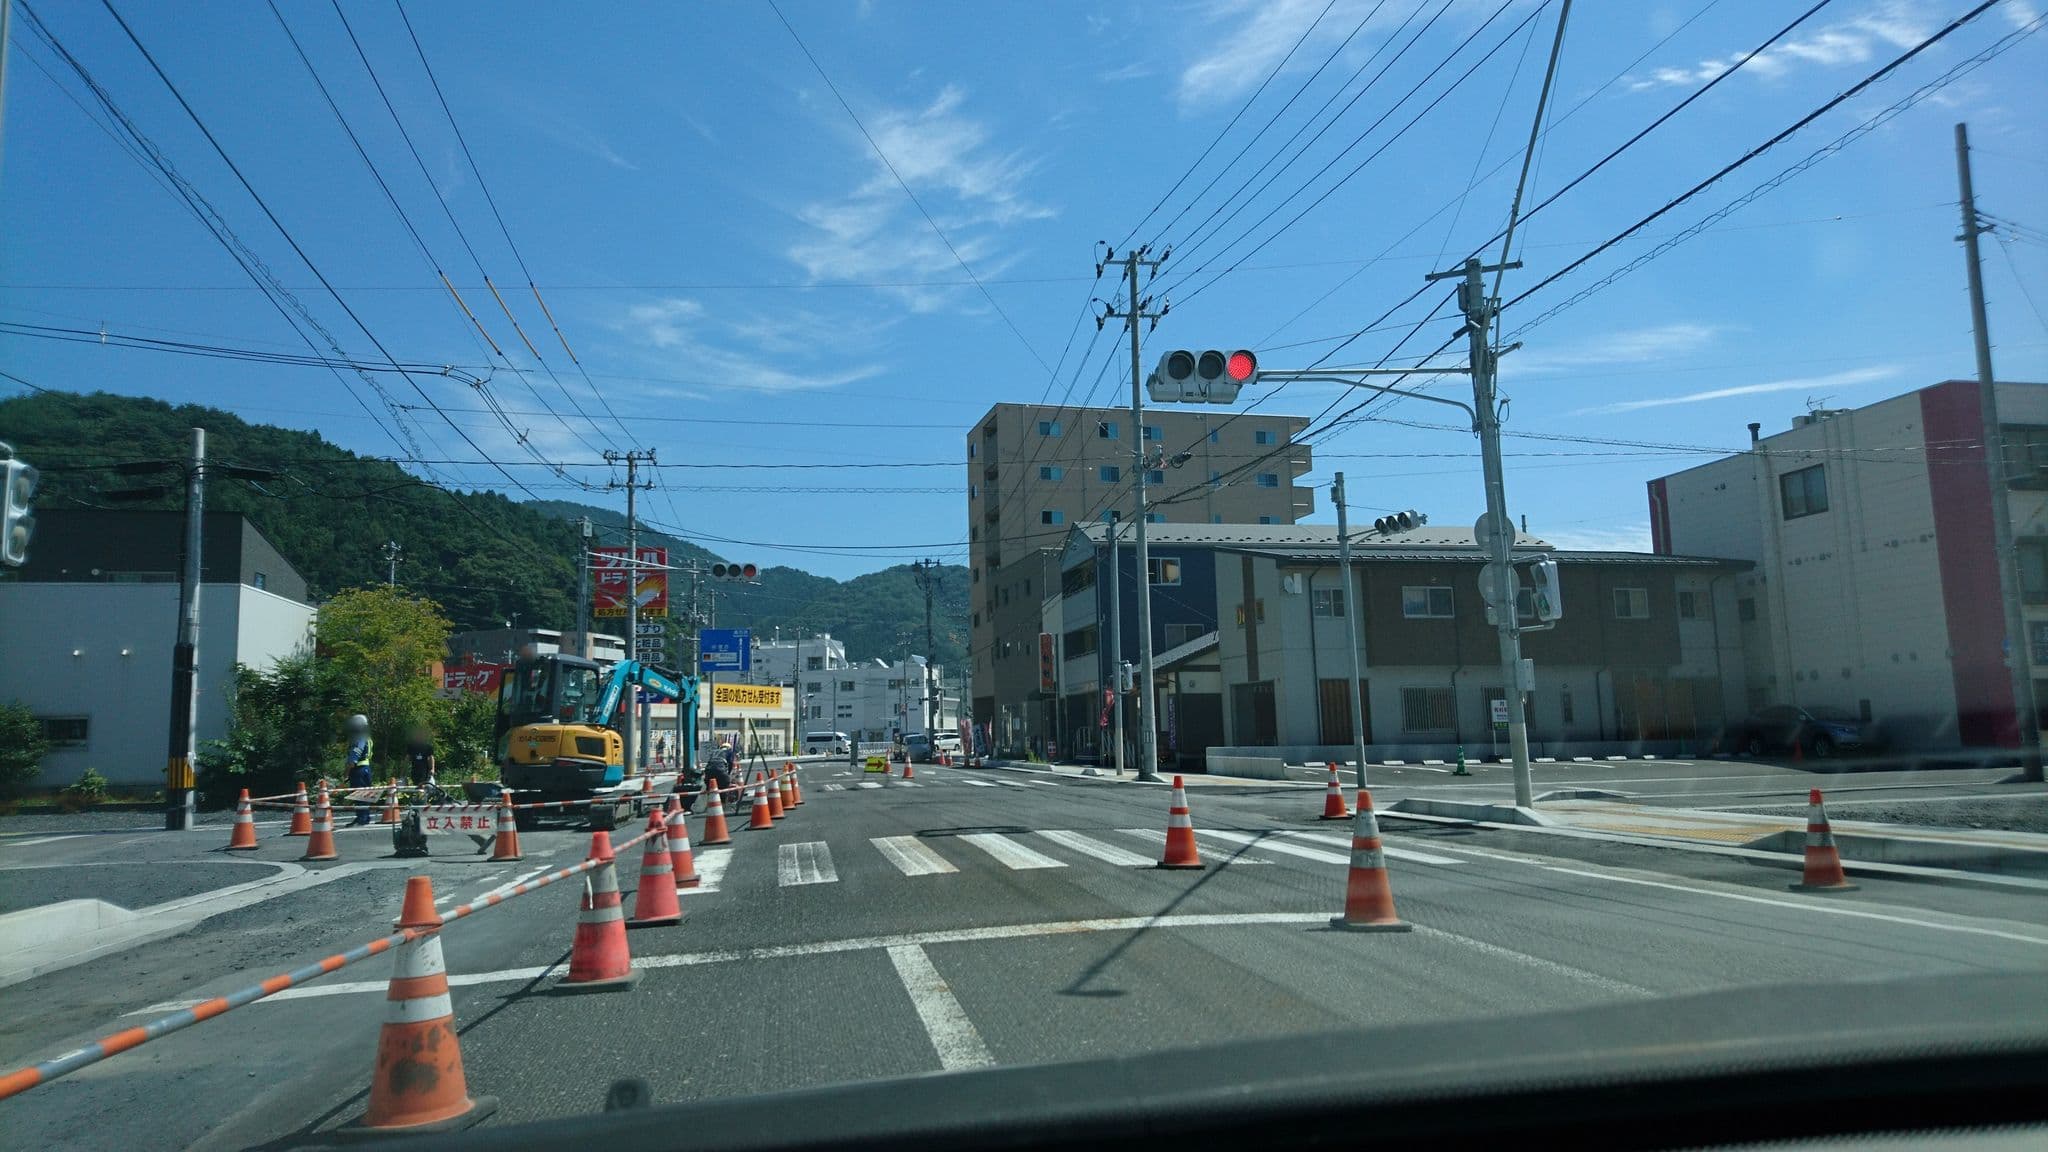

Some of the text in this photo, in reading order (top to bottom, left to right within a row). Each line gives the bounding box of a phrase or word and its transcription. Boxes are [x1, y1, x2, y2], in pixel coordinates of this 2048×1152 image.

[601, 572, 651, 585] ドラグ
[444, 670, 493, 688] ドラッグ
[715, 687, 781, 704] 全国の処方せん受付ます
[426, 815, 490, 831] 立入禁止
